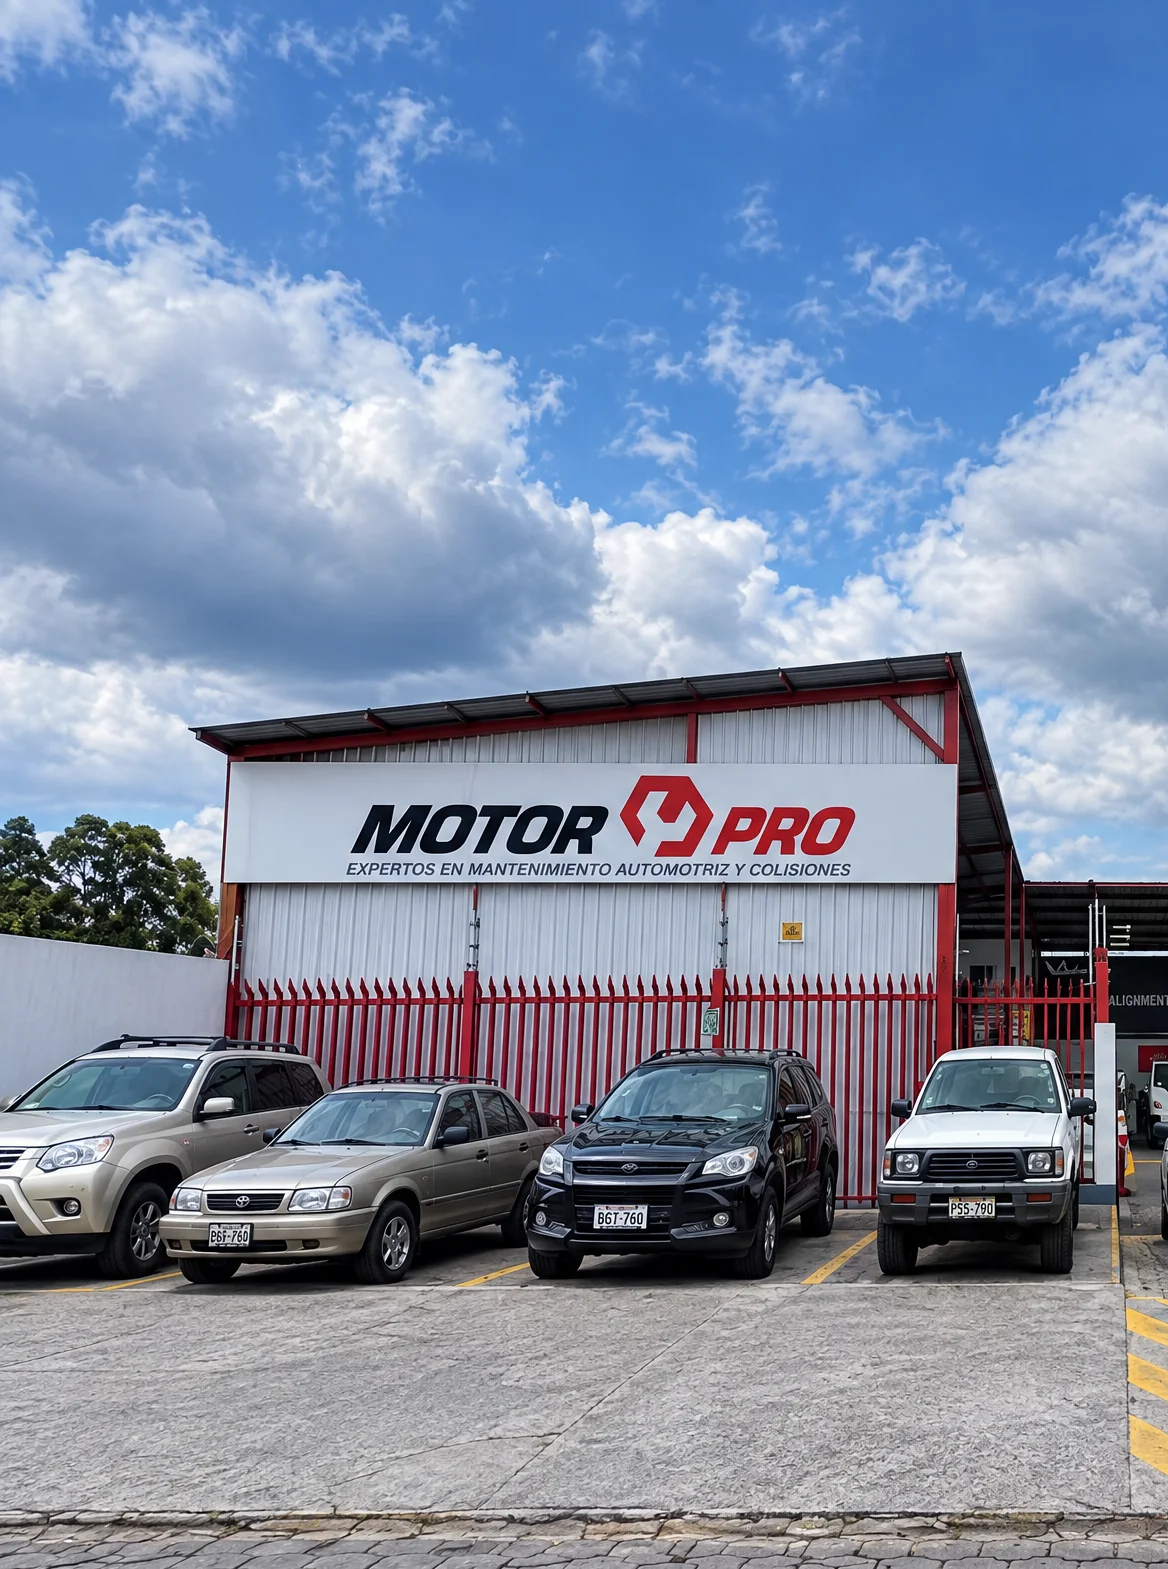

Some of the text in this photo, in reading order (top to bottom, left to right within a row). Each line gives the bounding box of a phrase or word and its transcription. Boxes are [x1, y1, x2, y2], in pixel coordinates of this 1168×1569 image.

[350, 804, 856, 855] MOTOR PRO
[346, 862, 851, 877] EXPERTOS EN MANTENIMIENTO AUTOMOTRIZ Y COLISIONES
